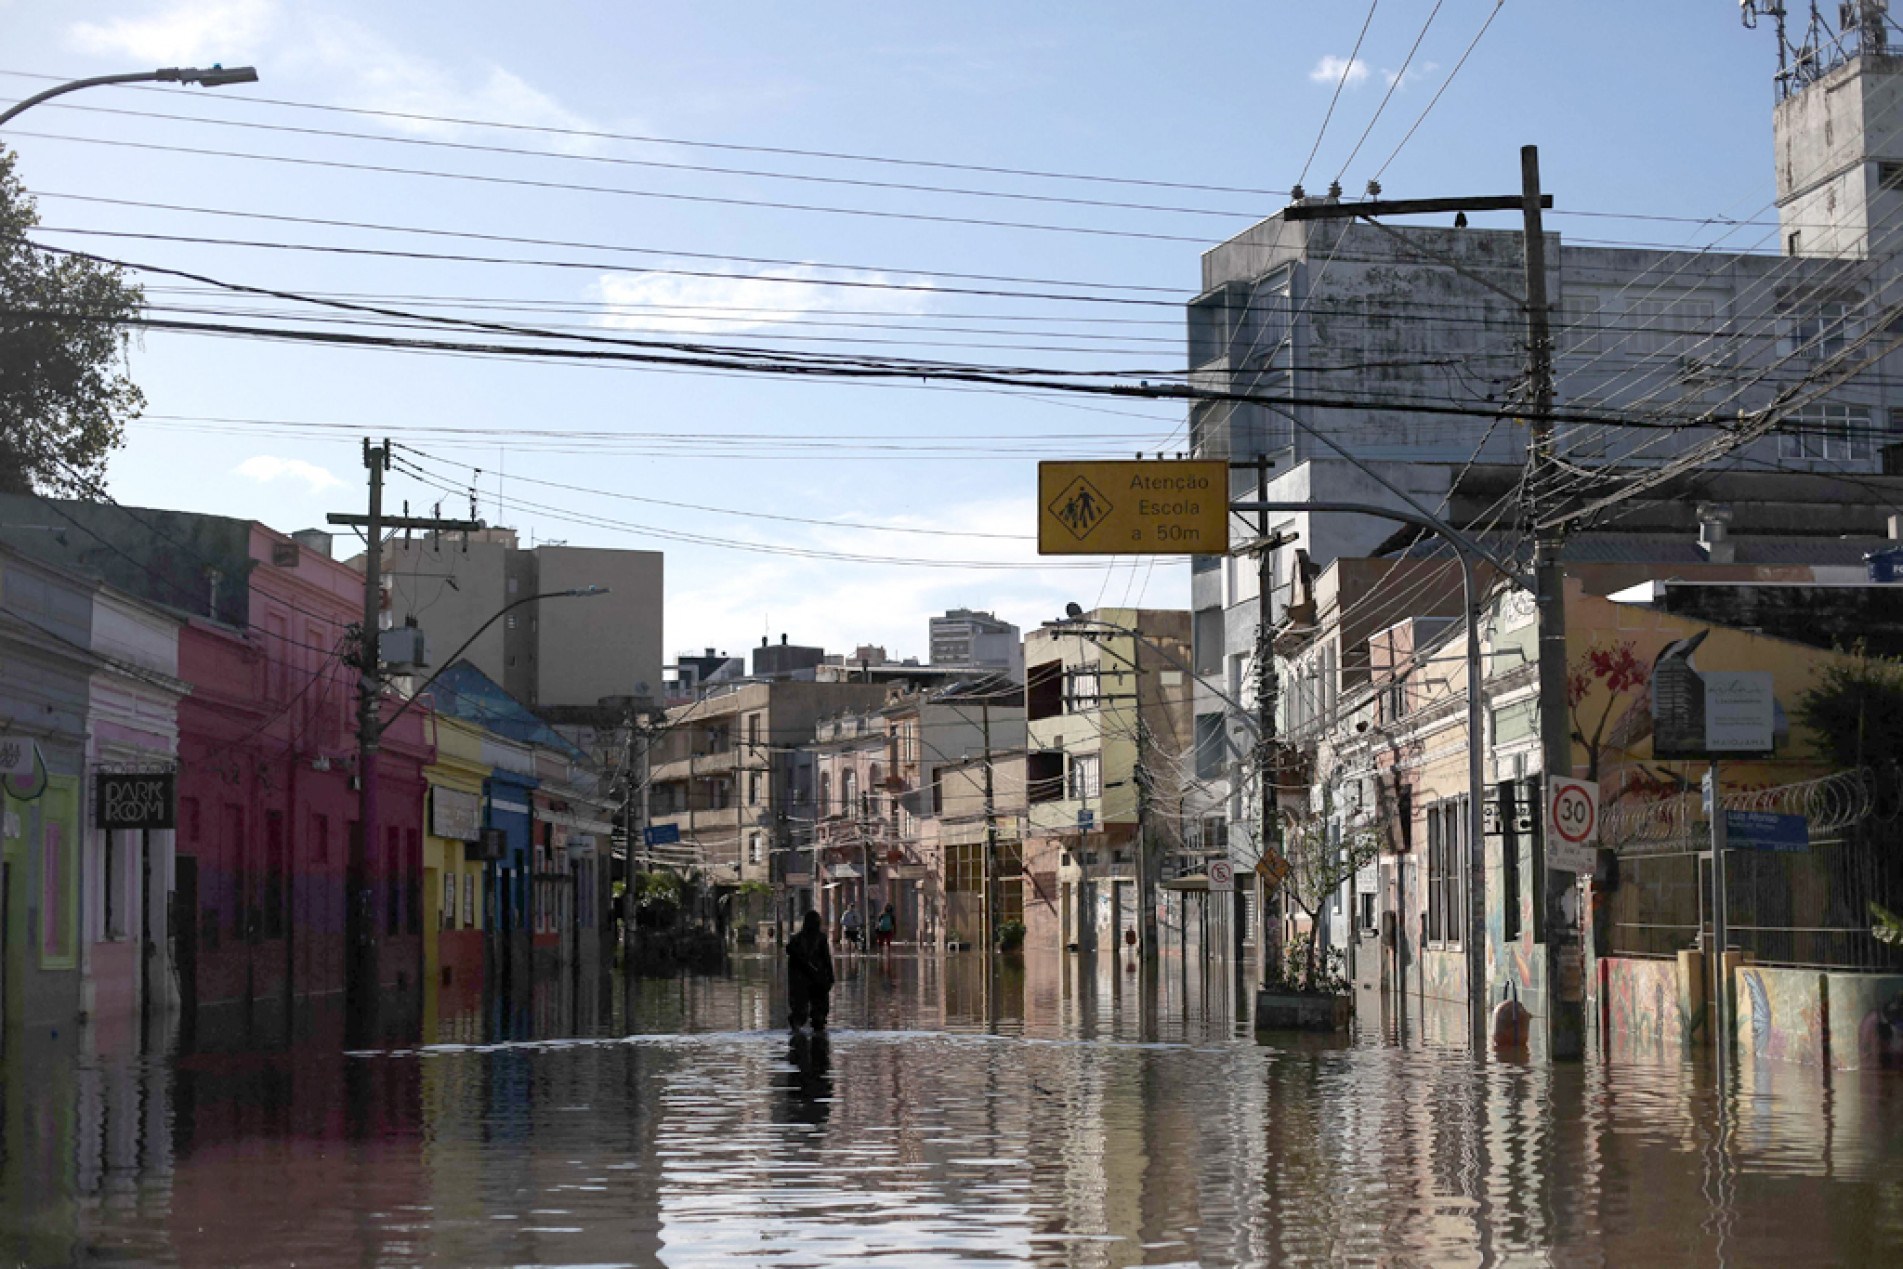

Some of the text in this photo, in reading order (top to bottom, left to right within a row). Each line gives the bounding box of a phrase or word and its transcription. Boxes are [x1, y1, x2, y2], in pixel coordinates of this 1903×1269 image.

[1129, 474, 1209, 493] Atenção
[1139, 500, 1200, 516] Escola
[1131, 525, 1200, 541] a 50m
[105, 781, 164, 800] DARK
[105, 800, 164, 821] ROOM
[1561, 798, 1586, 824] 30
